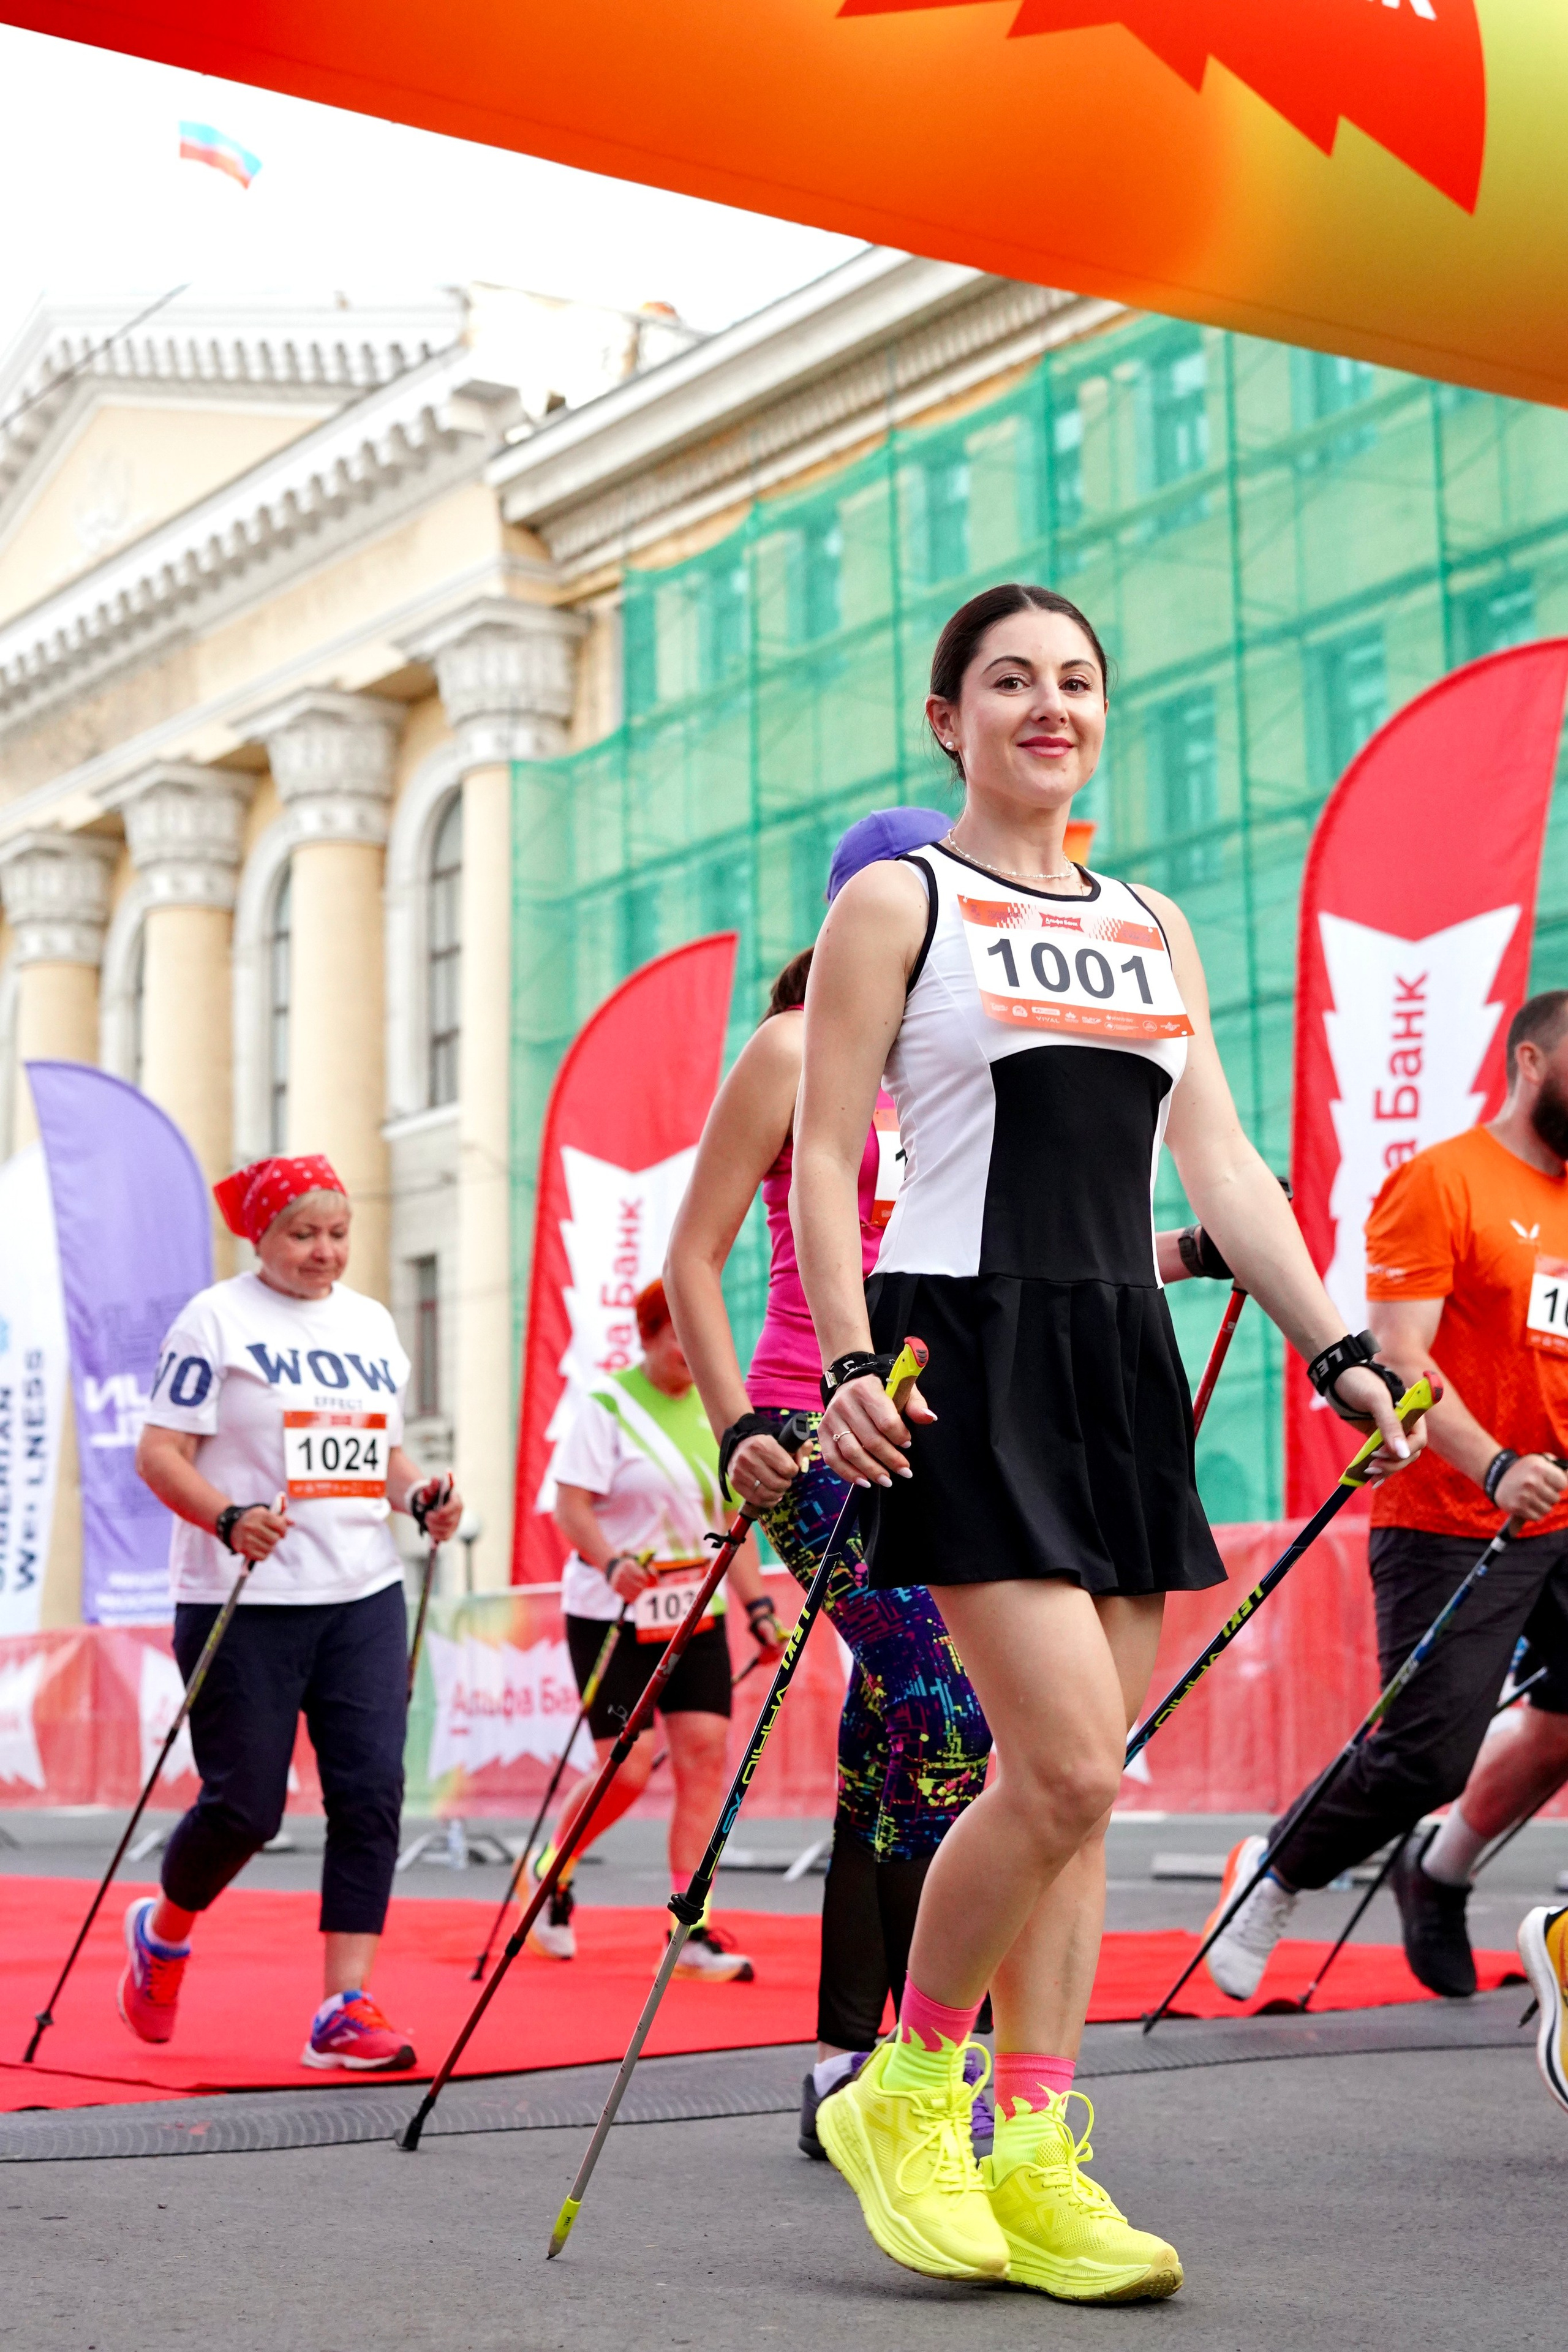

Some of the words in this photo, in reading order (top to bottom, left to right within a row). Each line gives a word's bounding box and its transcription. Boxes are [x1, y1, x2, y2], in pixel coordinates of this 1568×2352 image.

[987, 938, 1153, 1005] 1001
[1373, 970, 1428, 1121] Банк
[599, 1196, 644, 1308] Банк
[246, 1343, 399, 1395] WOW
[314, 1396, 363, 1408] EFFECT
[298, 1437, 379, 1471] 1024
[782, 1607, 810, 1670] LEKI
[1223, 1584, 1264, 1638] LEKI
